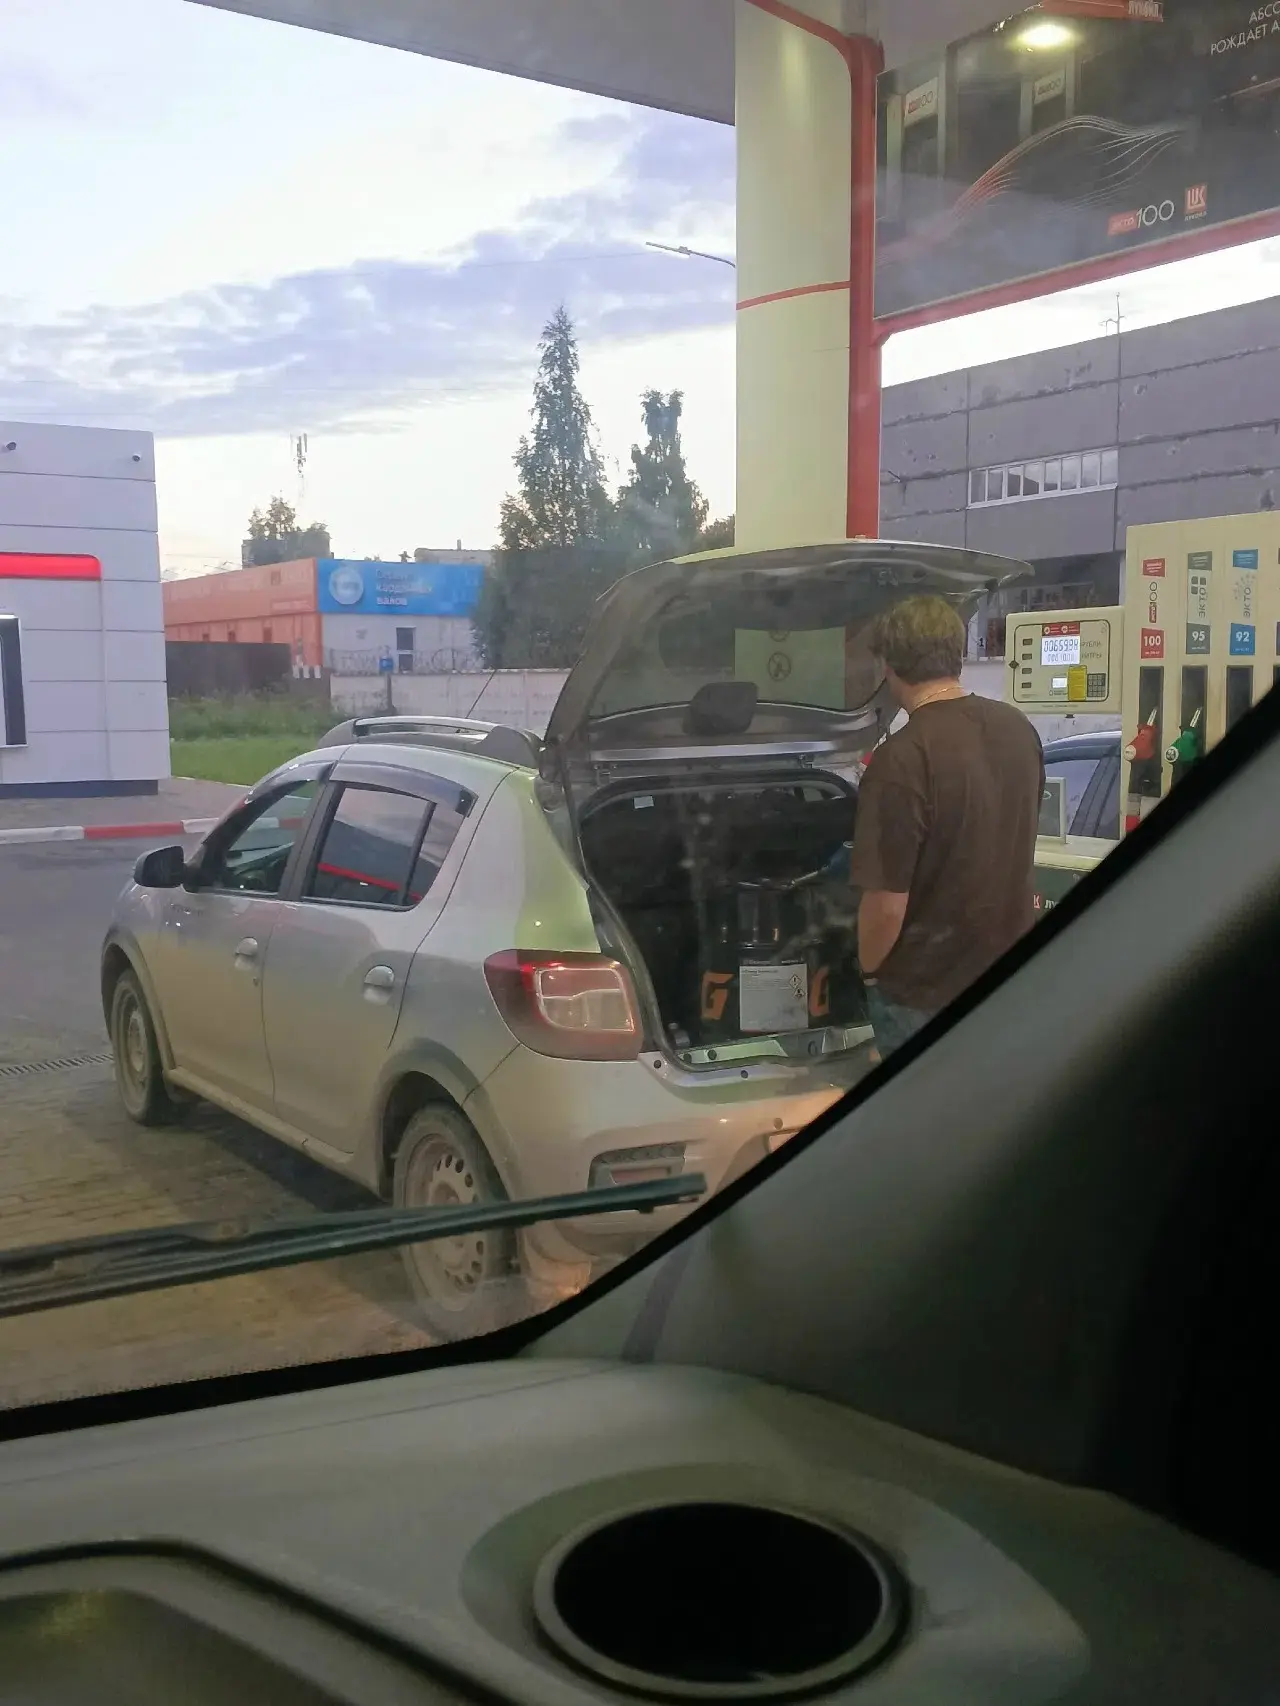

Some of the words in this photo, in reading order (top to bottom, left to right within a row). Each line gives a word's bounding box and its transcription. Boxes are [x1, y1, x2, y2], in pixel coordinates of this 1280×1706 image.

[1211, 23, 1268, 55] РОЖДАЕТ
[1143, 635, 1161, 647] 100
[1192, 630, 1206, 642] 95
[1235, 631, 1250, 642] 92
